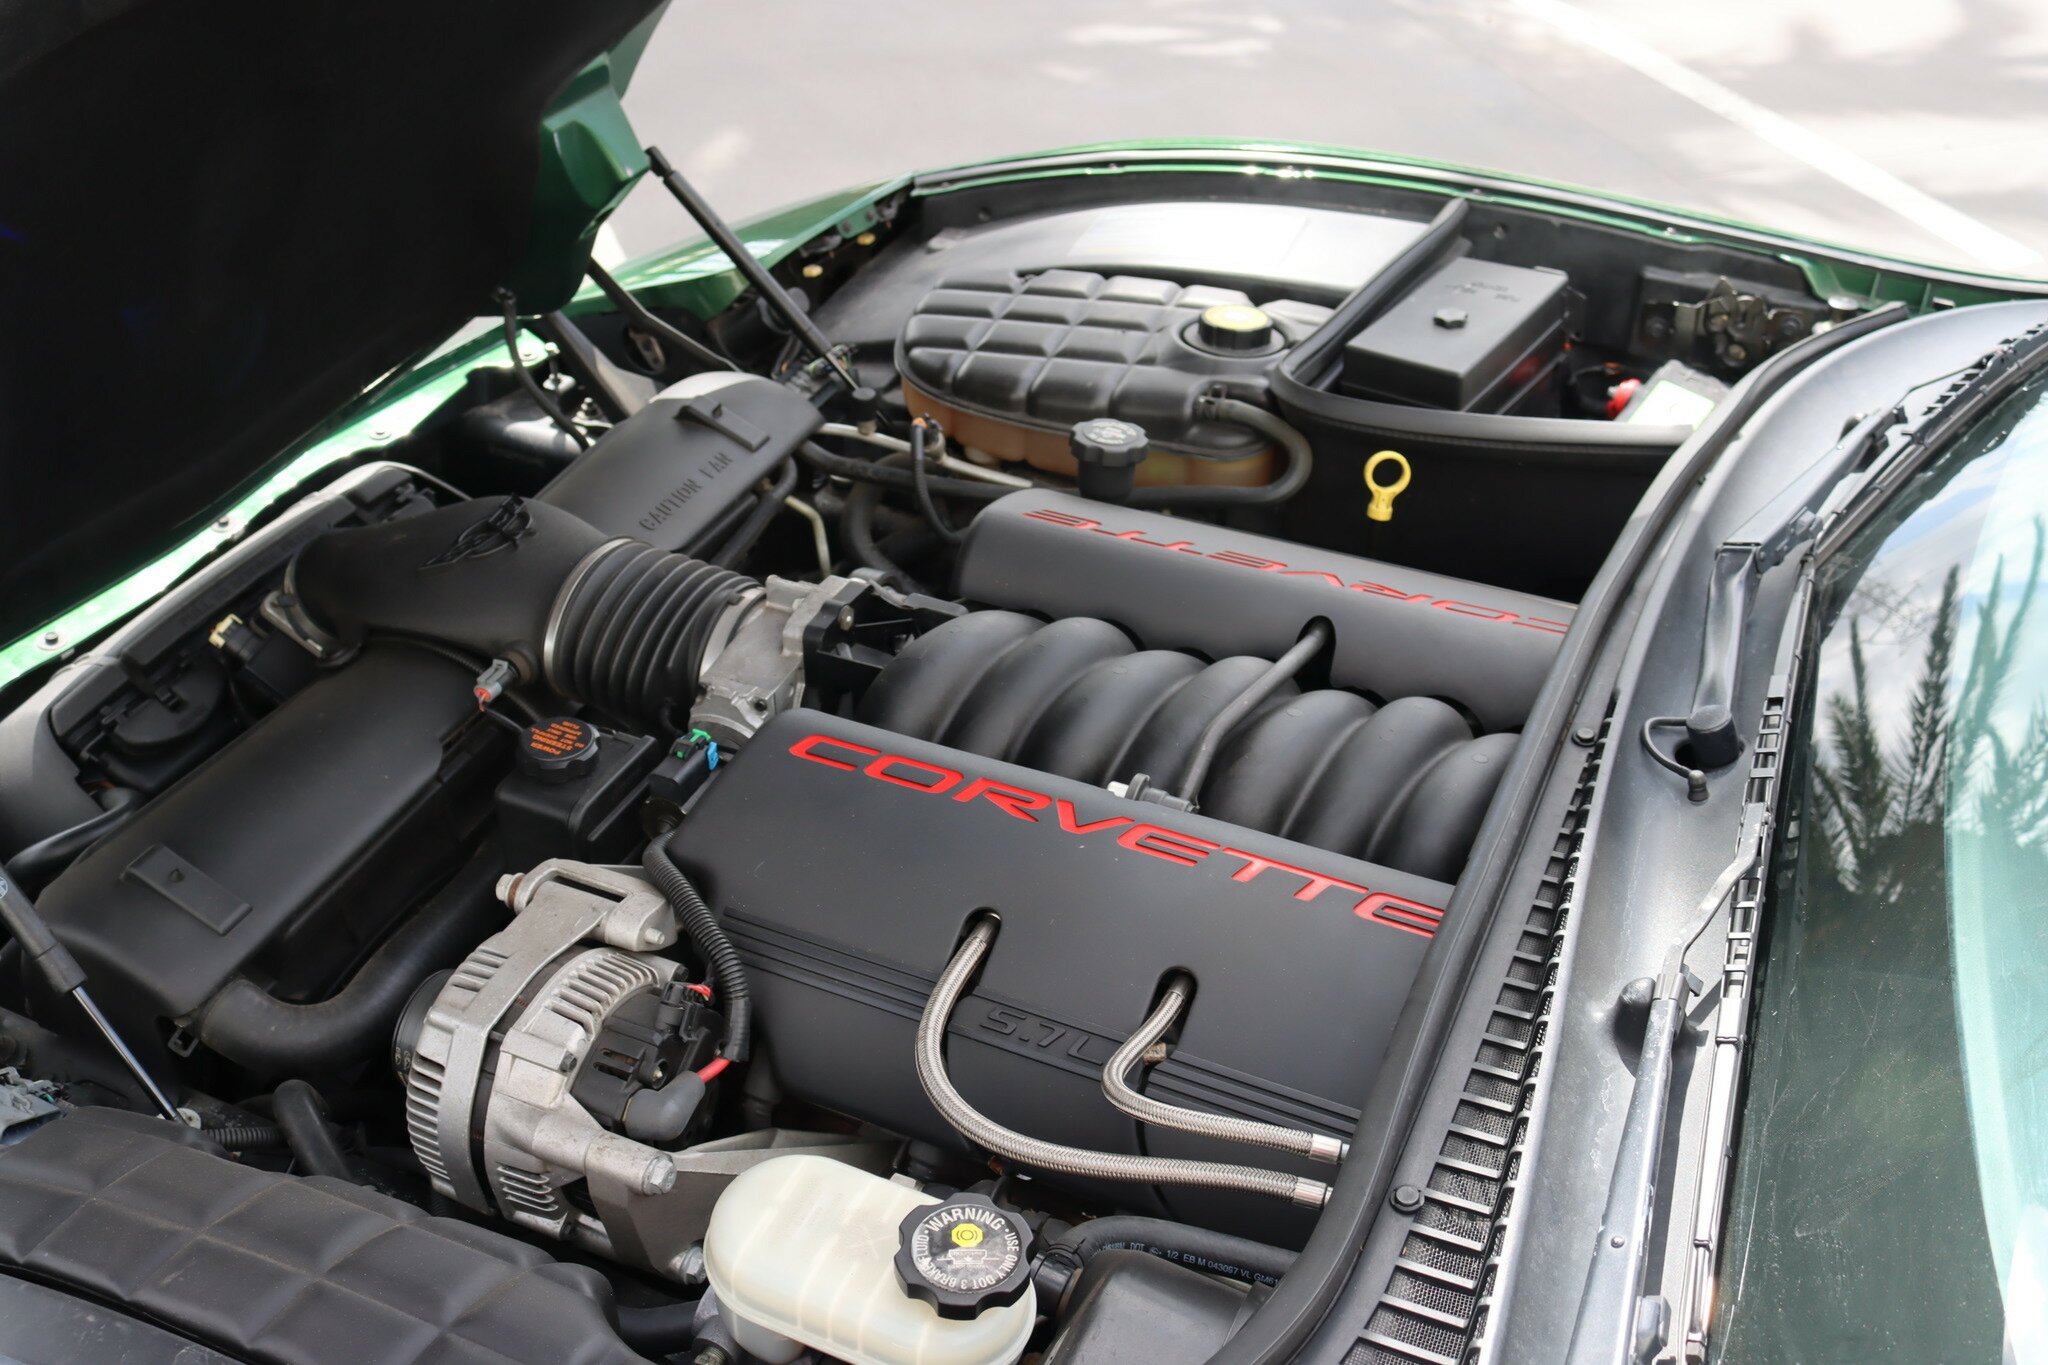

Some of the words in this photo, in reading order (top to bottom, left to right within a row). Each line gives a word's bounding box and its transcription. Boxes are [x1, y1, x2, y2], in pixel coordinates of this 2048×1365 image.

[638, 477, 704, 531] CAUTION
[697, 451, 734, 479] FAN
[530, 741, 561, 755] POWER
[531, 733, 573, 751] STEERING
[788, 733, 1447, 939] CORVETTE
[979, 1005, 1101, 1065] 5.7L
[924, 1207, 1006, 1232] WARNING
[1004, 1232, 1019, 1252] USE
[1130, 1242, 1145, 1253] DOT
[1167, 1249, 1179, 1260] 1/2
[1197, 1257, 1206, 1266] M
[996, 1256, 1018, 1280] ONLY
[960, 1279, 968, 1290] 3
[972, 1274, 996, 1290] DOT
